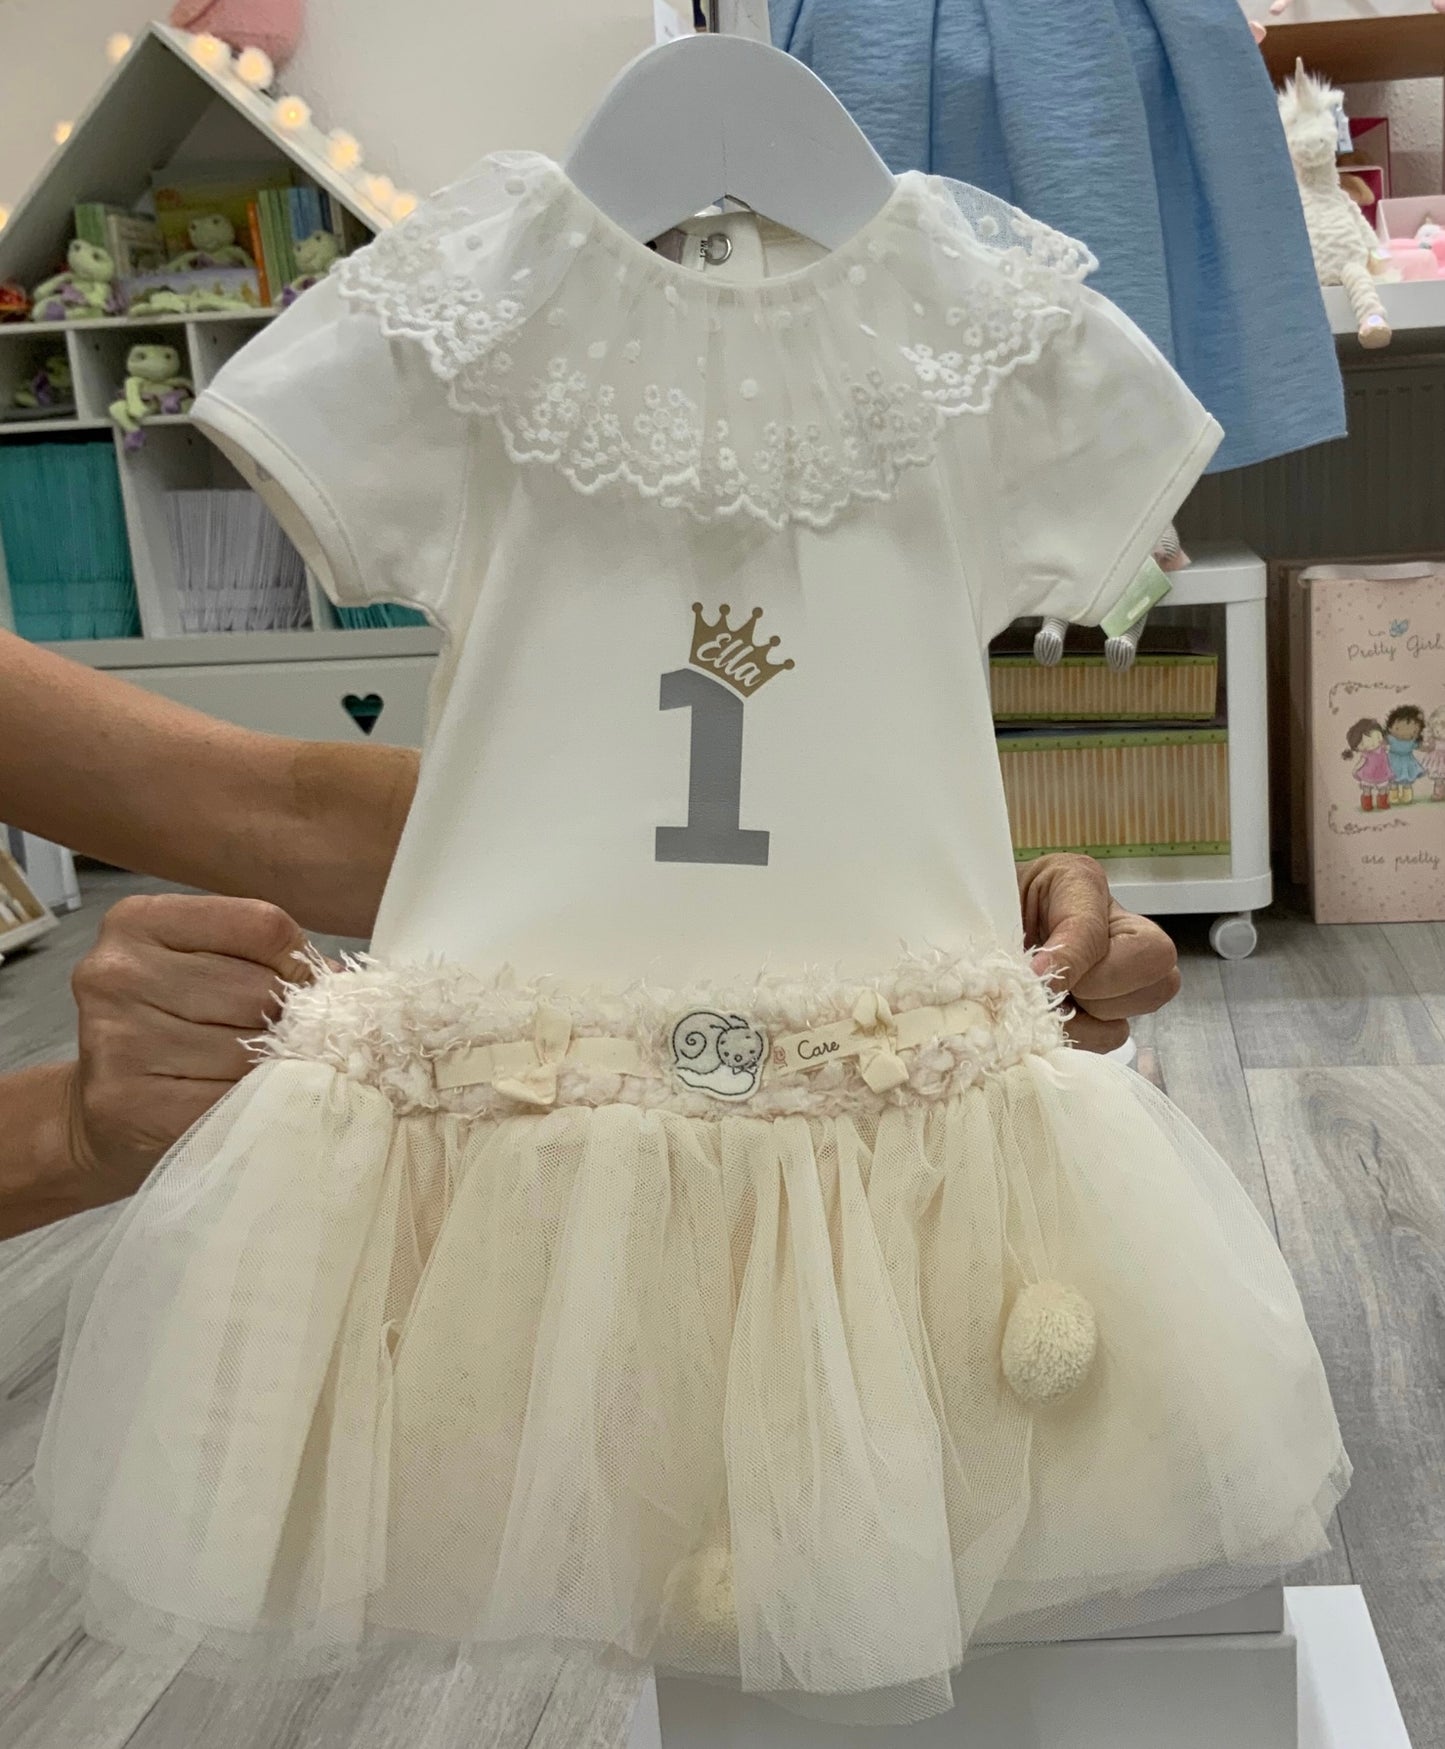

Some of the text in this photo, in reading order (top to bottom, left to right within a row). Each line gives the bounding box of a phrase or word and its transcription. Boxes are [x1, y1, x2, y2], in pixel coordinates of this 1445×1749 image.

[695, 632, 761, 687] Ella
[1347, 632, 1445, 661] Pretty Girl
[655, 668, 770, 866] 1
[1361, 850, 1440, 872] are pretty
[797, 1039, 840, 1060] Care
